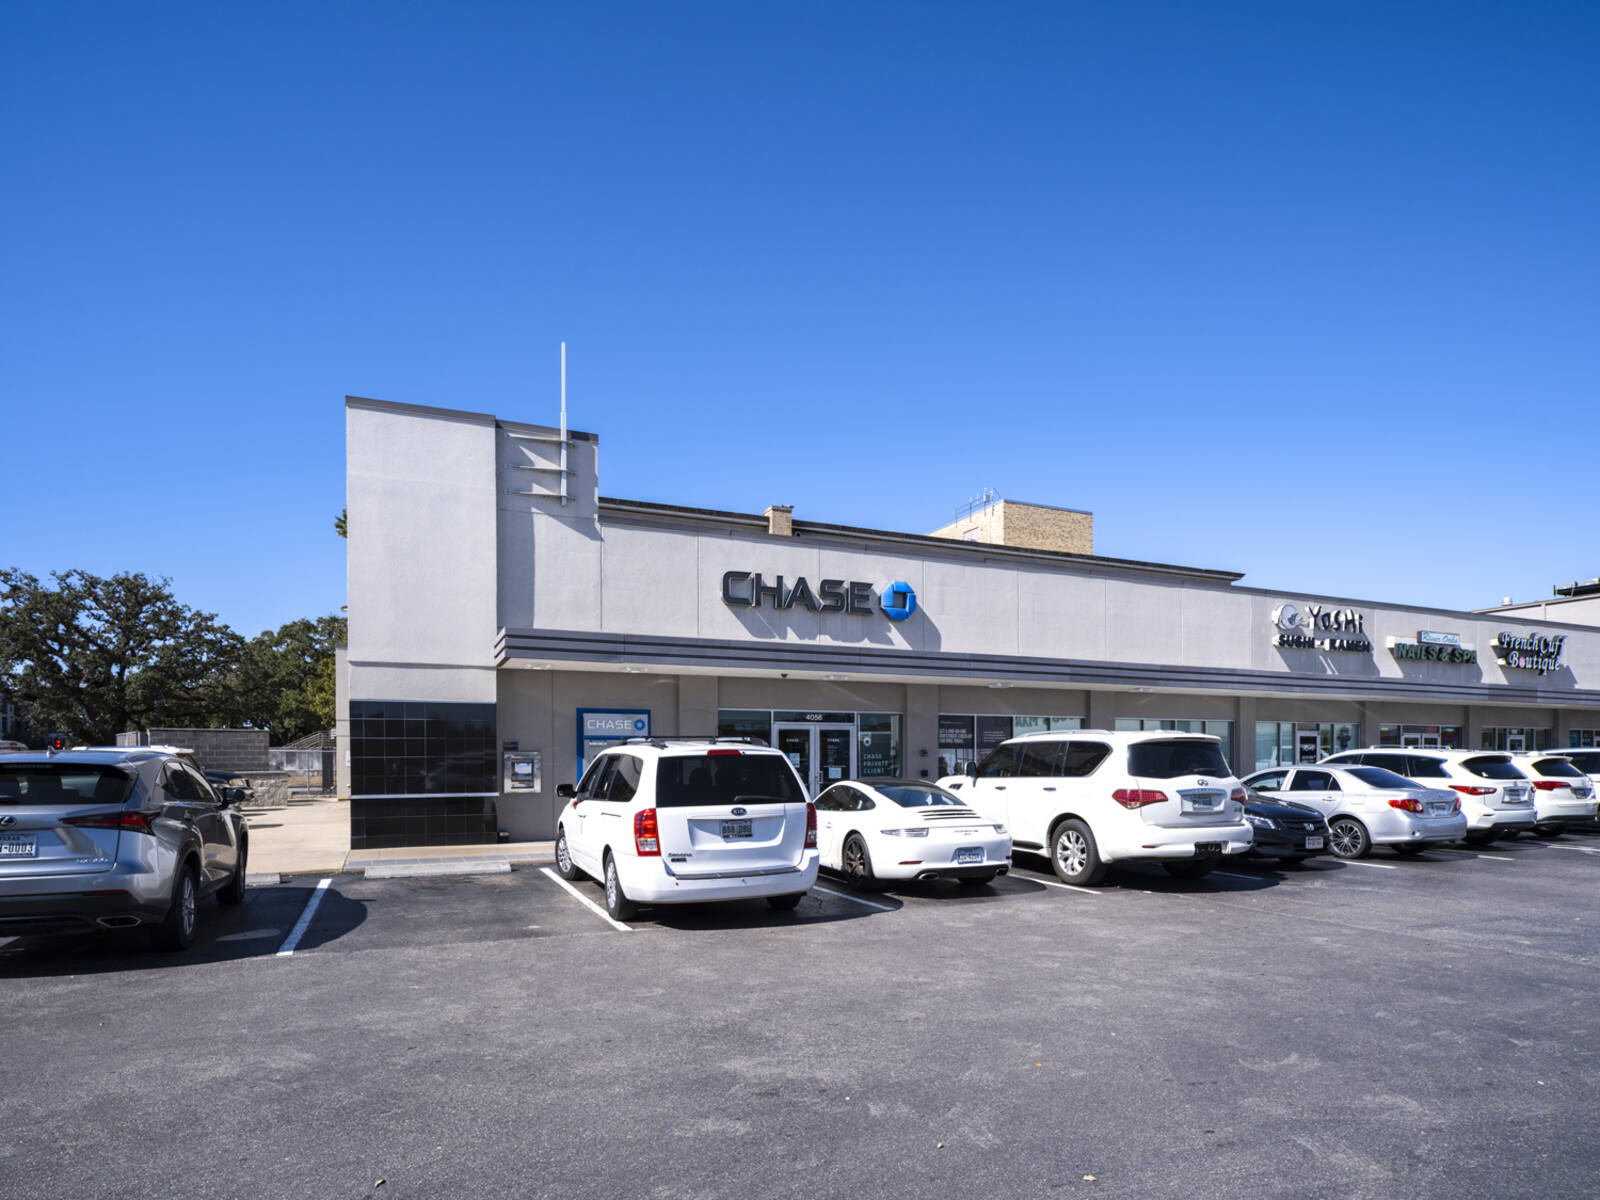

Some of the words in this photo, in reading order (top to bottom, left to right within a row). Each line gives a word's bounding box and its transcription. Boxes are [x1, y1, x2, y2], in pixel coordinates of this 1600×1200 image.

[722, 571, 874, 616] CHASE
[1277, 634, 1316, 650] SUSHI
[1328, 638, 1371, 653] RAMEN
[1498, 631, 1539, 651] French
[1396, 643, 1438, 661] NAILS
[1439, 647, 1451, 663] &
[1454, 648, 1477, 664] SPA
[1506, 650, 1561, 676] Boutique
[586, 719, 633, 730] CHASE
[863, 767, 885, 775] CLIENT
